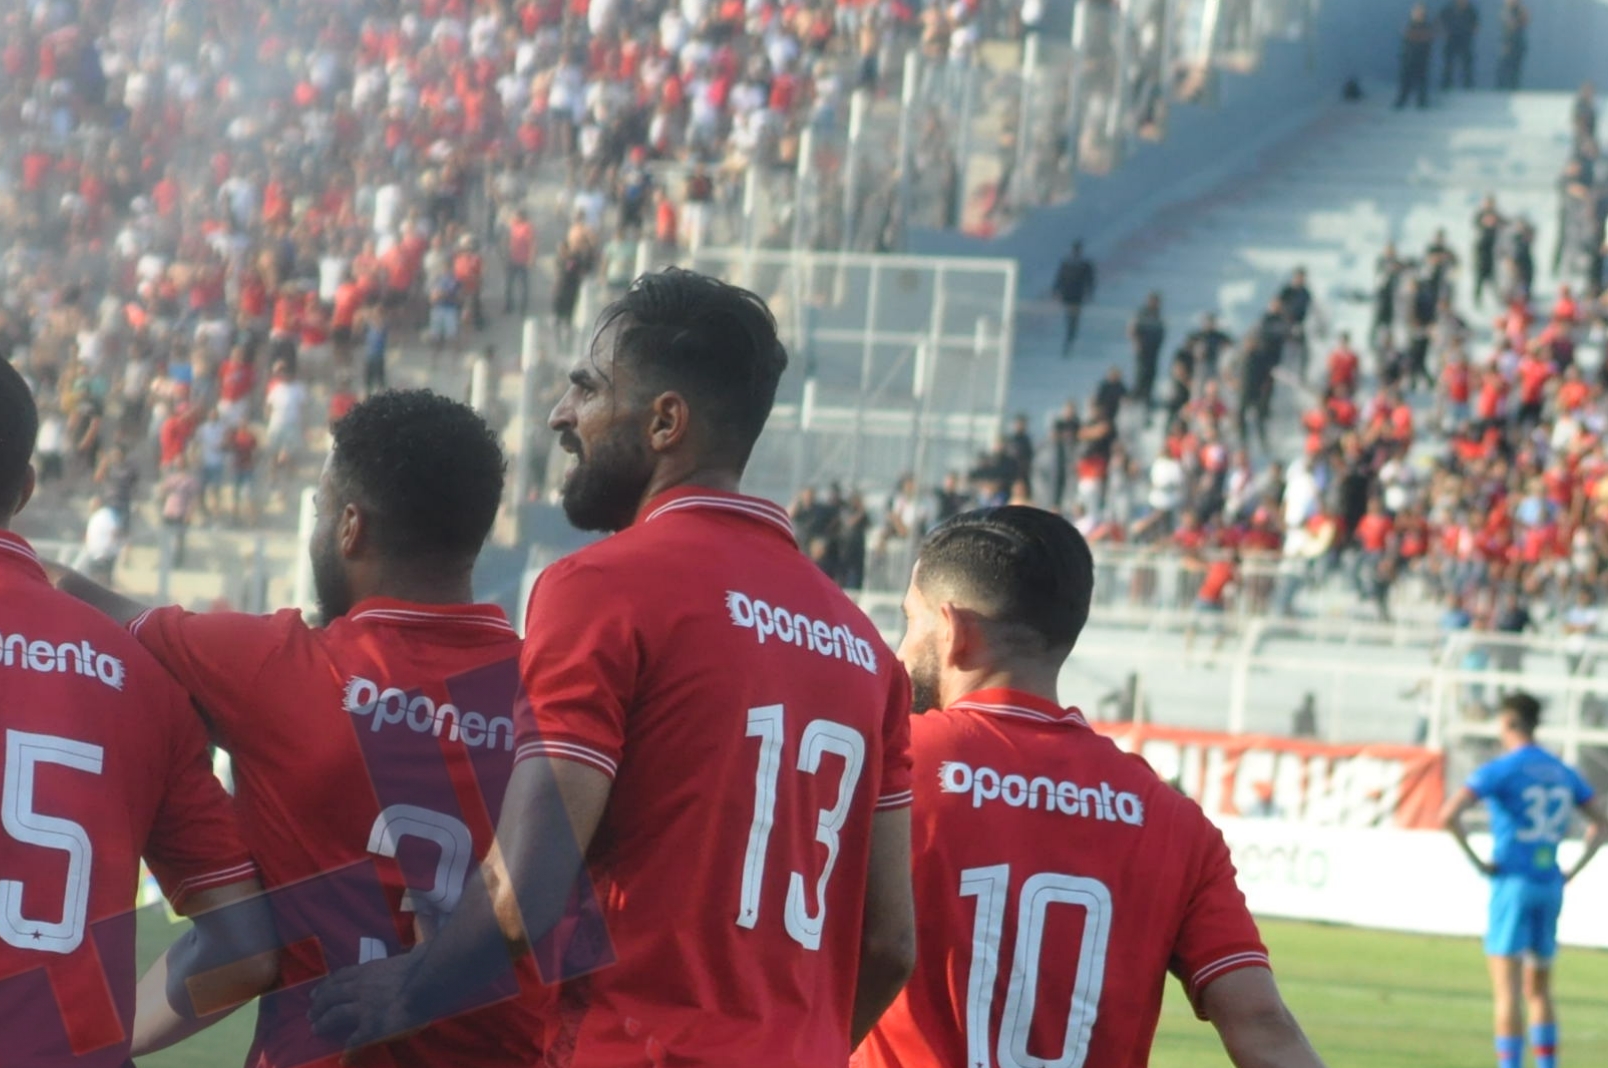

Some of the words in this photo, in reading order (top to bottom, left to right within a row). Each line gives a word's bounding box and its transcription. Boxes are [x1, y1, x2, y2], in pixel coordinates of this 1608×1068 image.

[726, 590, 877, 674] oponento
[342, 675, 514, 751] oponen
[736, 704, 865, 951] 13
[938, 761, 1144, 825] oponento
